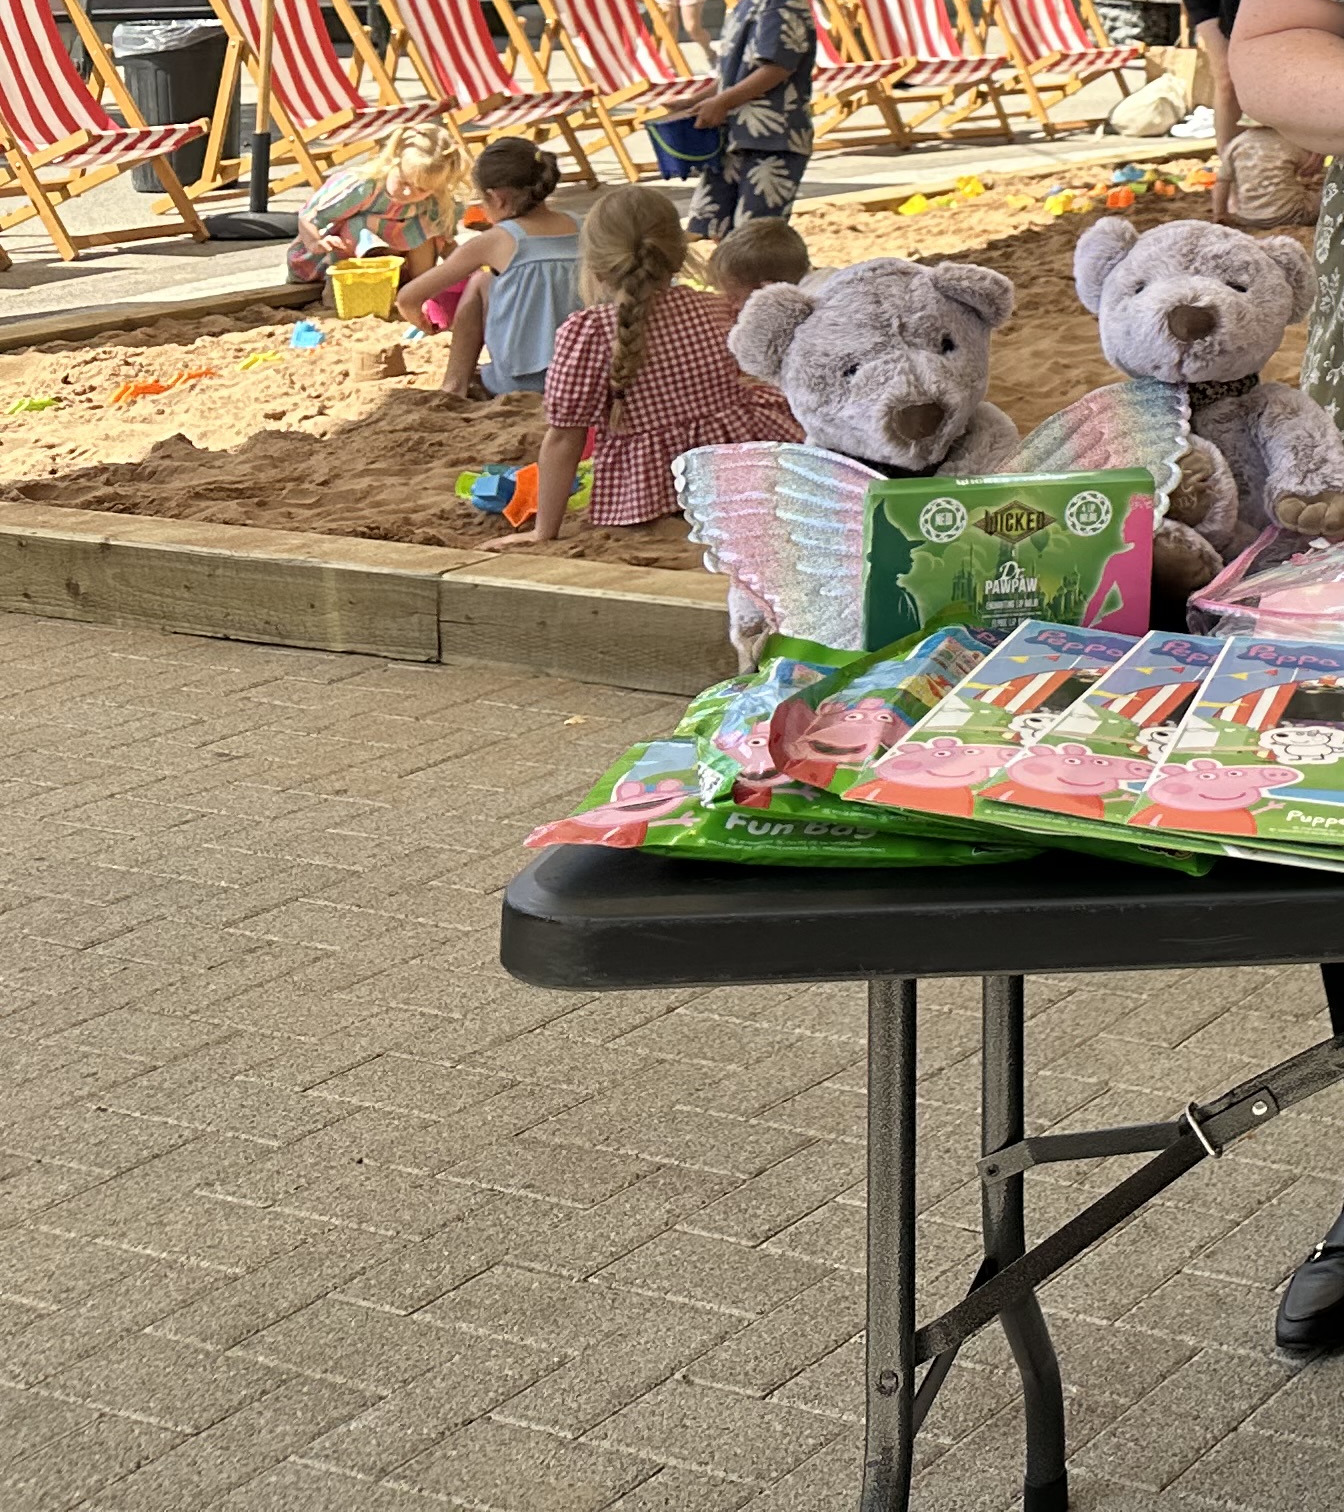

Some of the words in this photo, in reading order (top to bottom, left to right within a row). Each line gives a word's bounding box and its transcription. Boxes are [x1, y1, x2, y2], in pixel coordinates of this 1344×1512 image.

[984, 509, 1046, 536] WICKED
[985, 578, 1037, 594] PAWPAW
[1037, 630, 1124, 657] Peppa
[1249, 644, 1340, 667] Peppa
[725, 812, 795, 835] Fun
